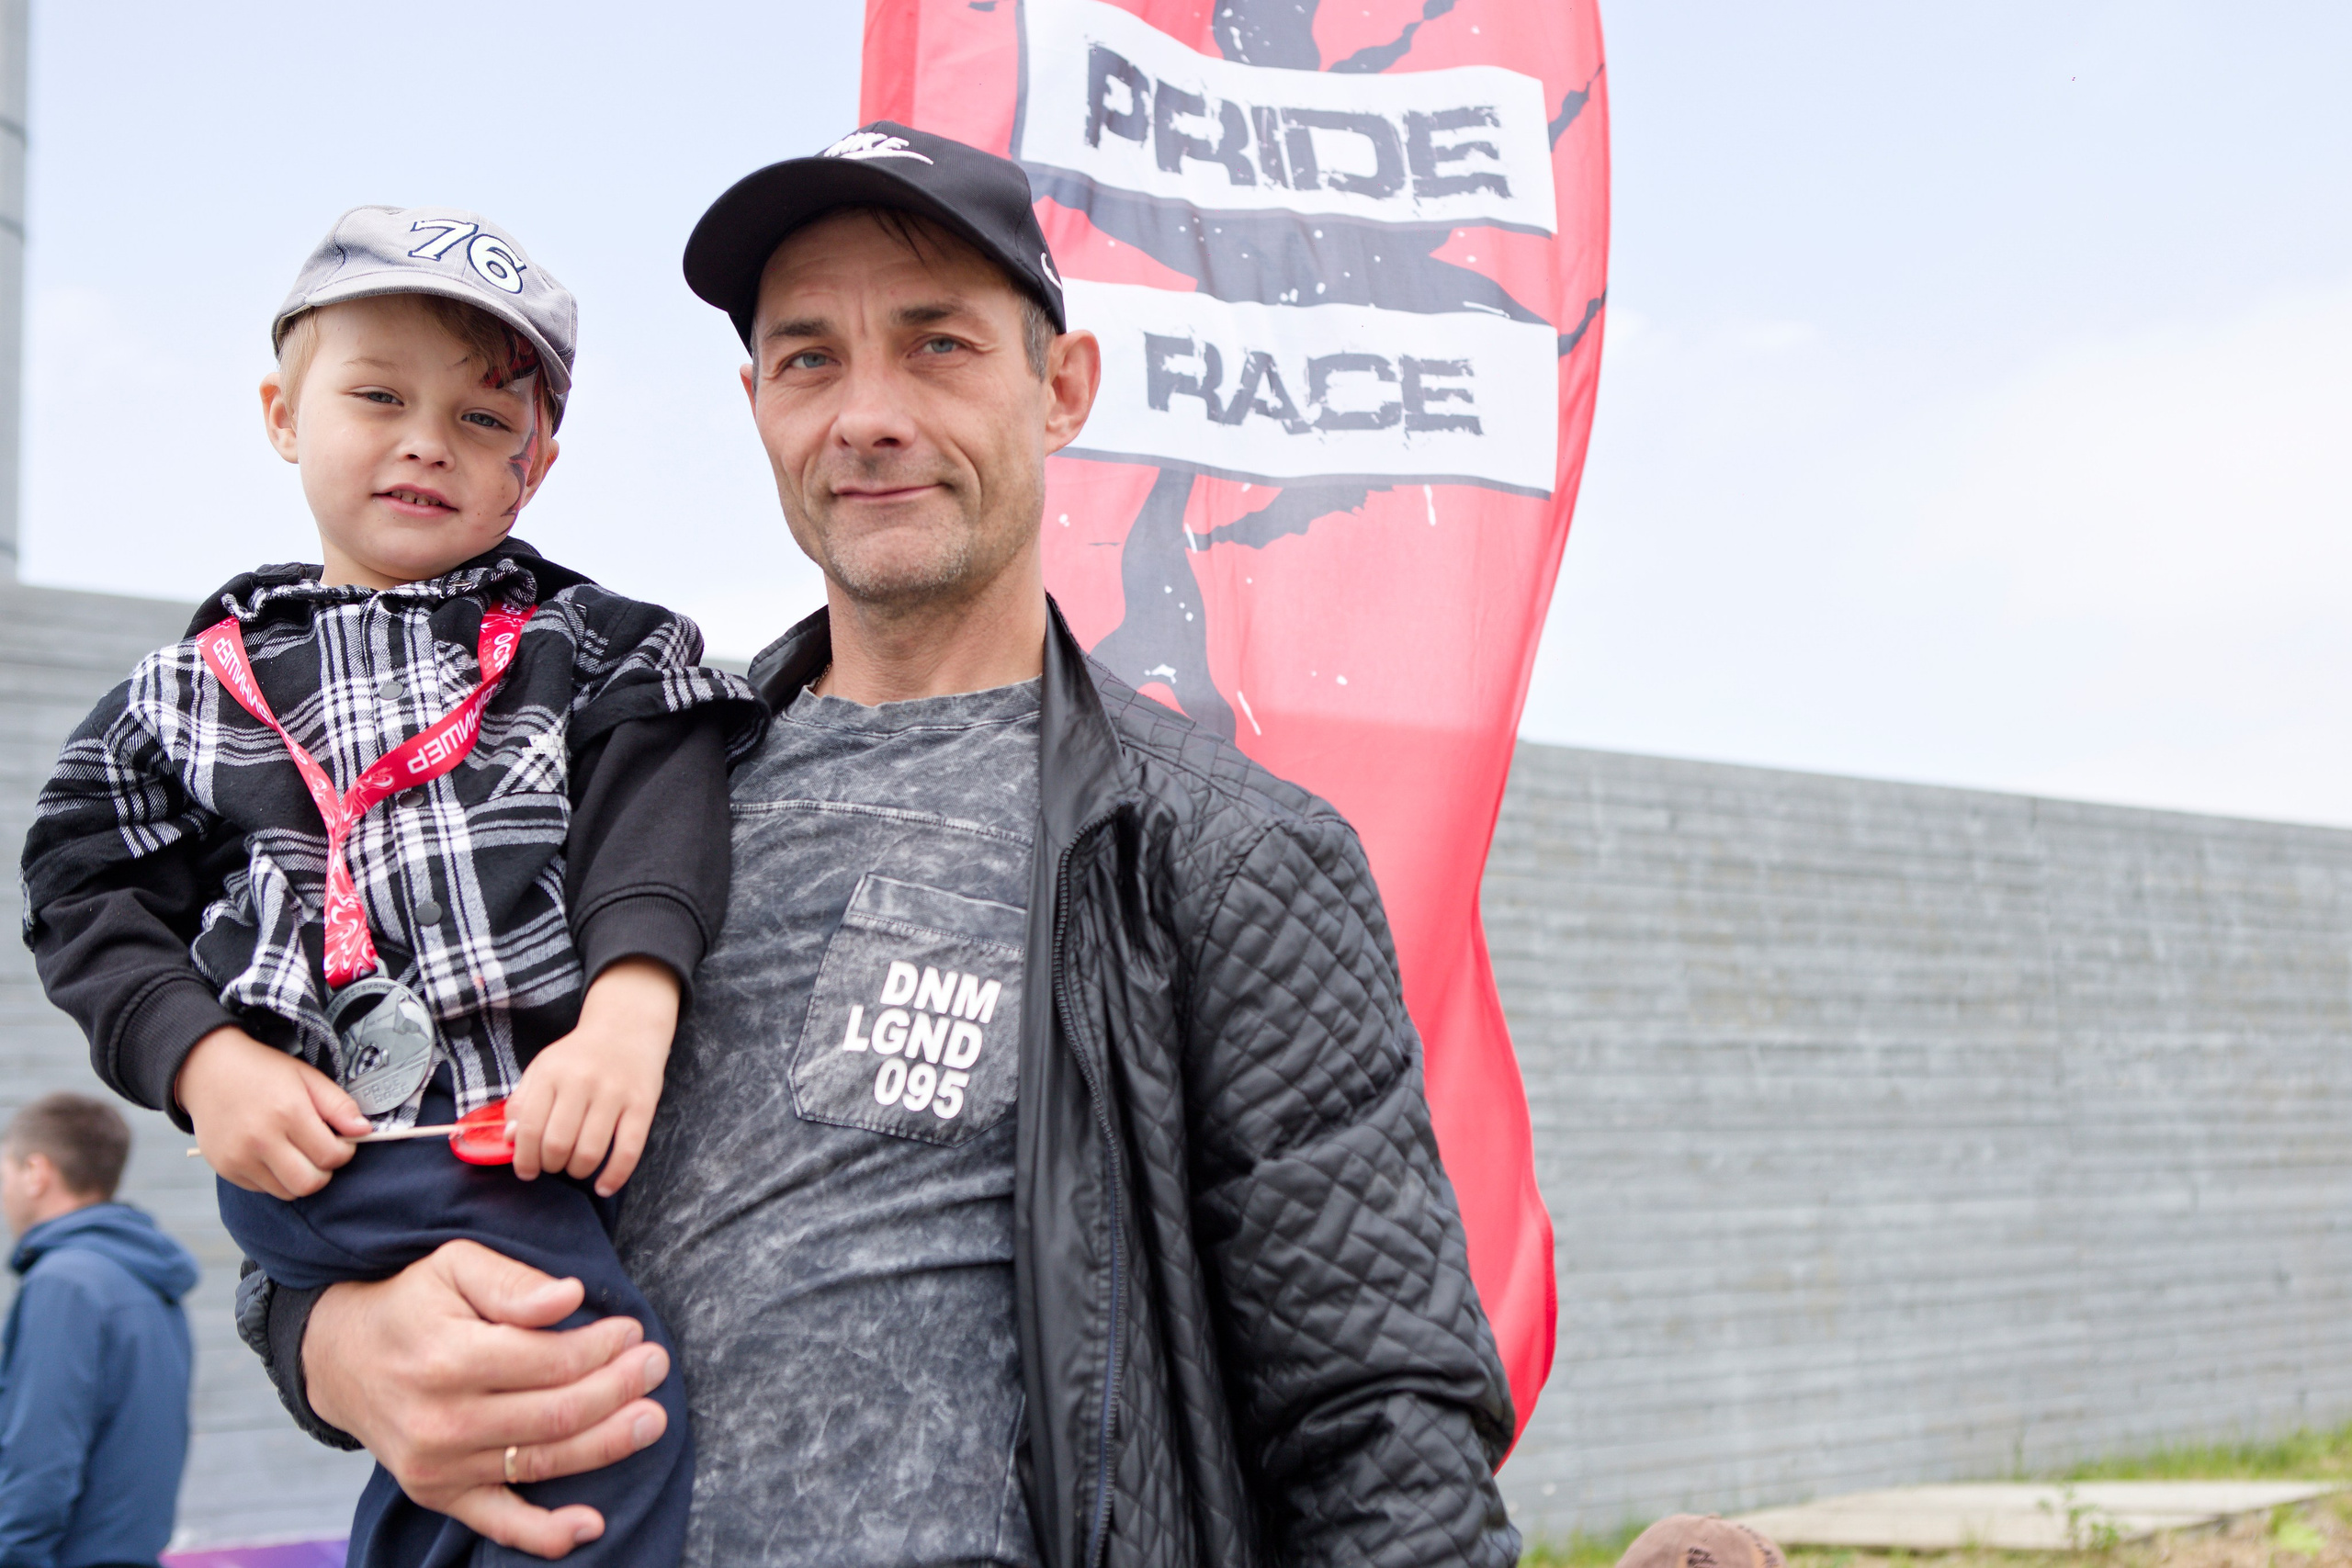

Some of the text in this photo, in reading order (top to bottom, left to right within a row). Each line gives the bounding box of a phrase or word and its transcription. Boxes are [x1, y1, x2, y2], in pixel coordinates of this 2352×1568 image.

[1084, 38, 1514, 202] PRIDE
[408, 219, 527, 294] 76
[1142, 330, 1485, 438] RACE
[482, 637, 494, 675] RUSSI
[879, 960, 1002, 1024] DNM
[842, 1004, 983, 1069] LGND
[874, 1056, 970, 1120] 095
